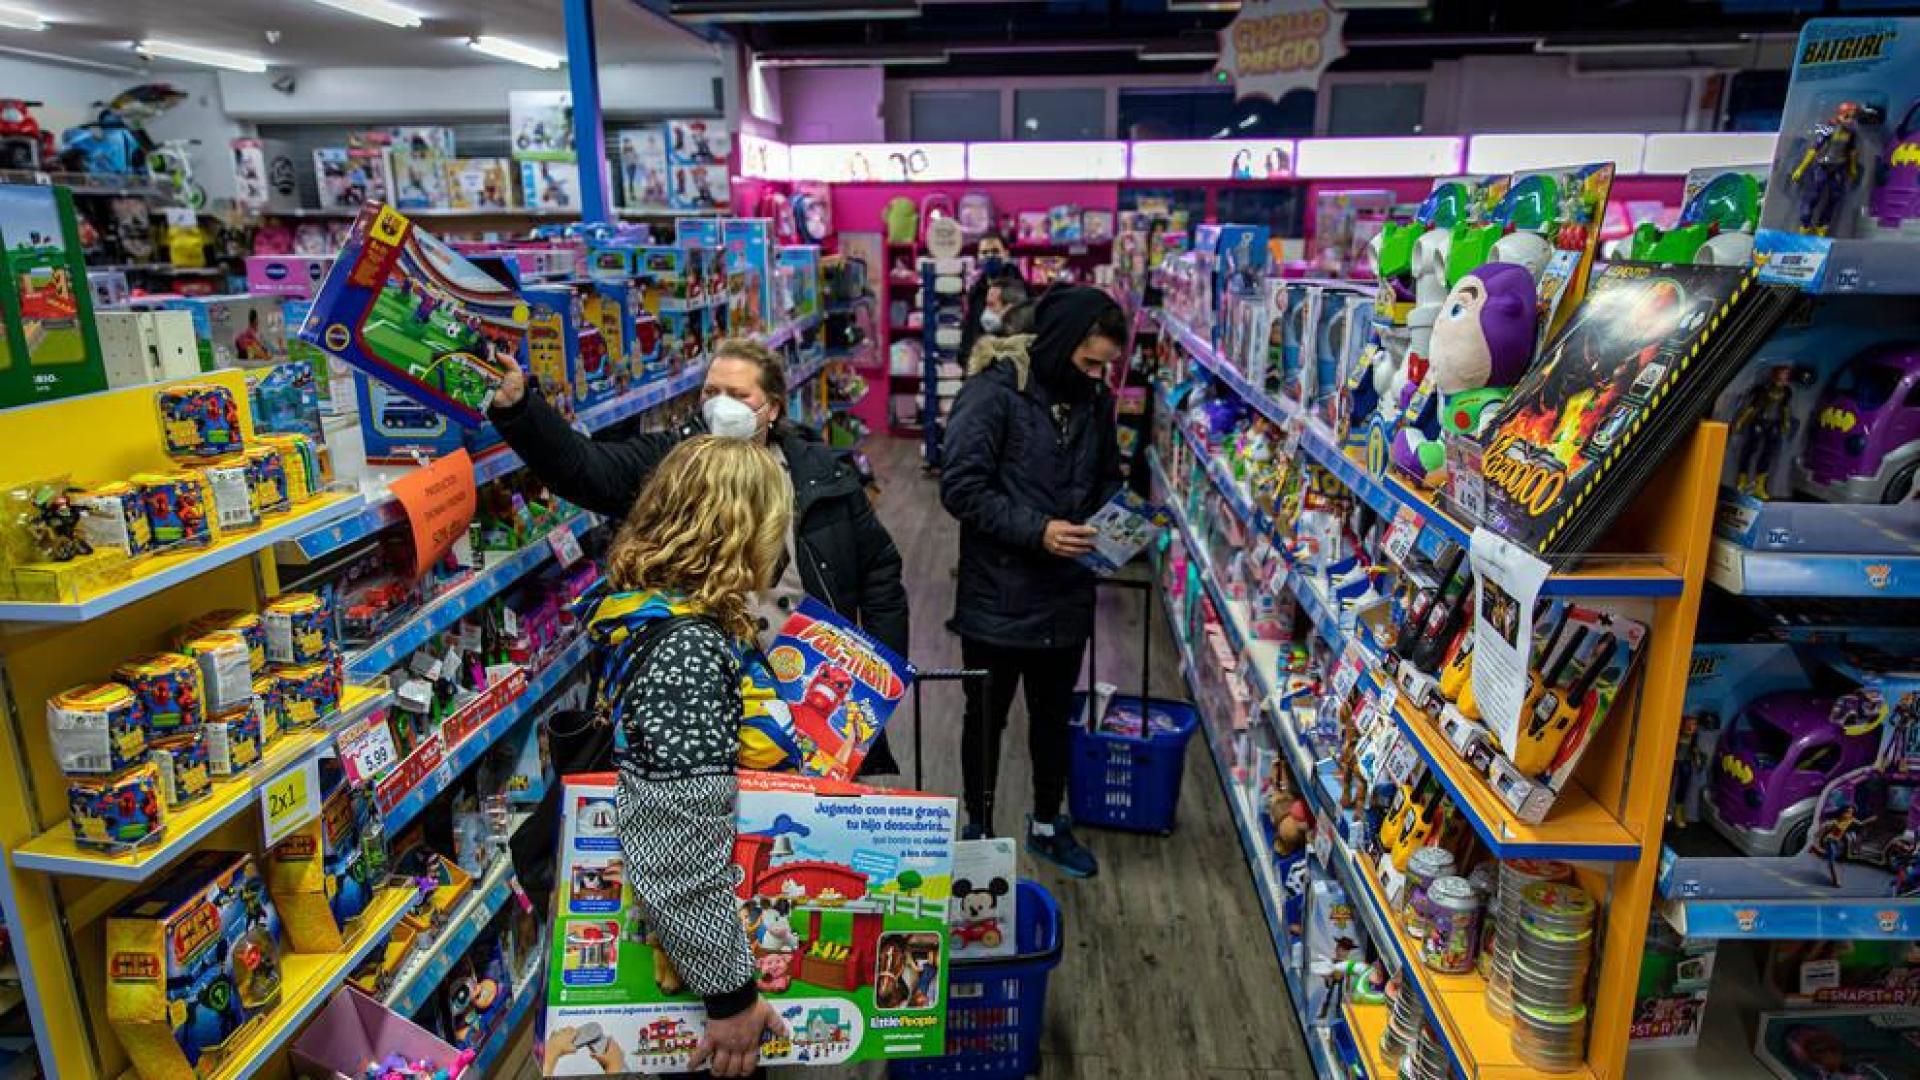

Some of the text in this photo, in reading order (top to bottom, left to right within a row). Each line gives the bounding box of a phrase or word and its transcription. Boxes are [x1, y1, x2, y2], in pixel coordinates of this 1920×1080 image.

[1239, 38, 1321, 75] PRECIO
[1802, 33, 1884, 64] BATGIRL
[1768, 530, 1790, 544] DC
[269, 784, 296, 817] 2x1
[814, 802, 863, 817] Jugando
[865, 805, 887, 815] con
[888, 806, 913, 816] esta
[847, 819, 859, 831] tu
[861, 819, 881, 832] hijo
